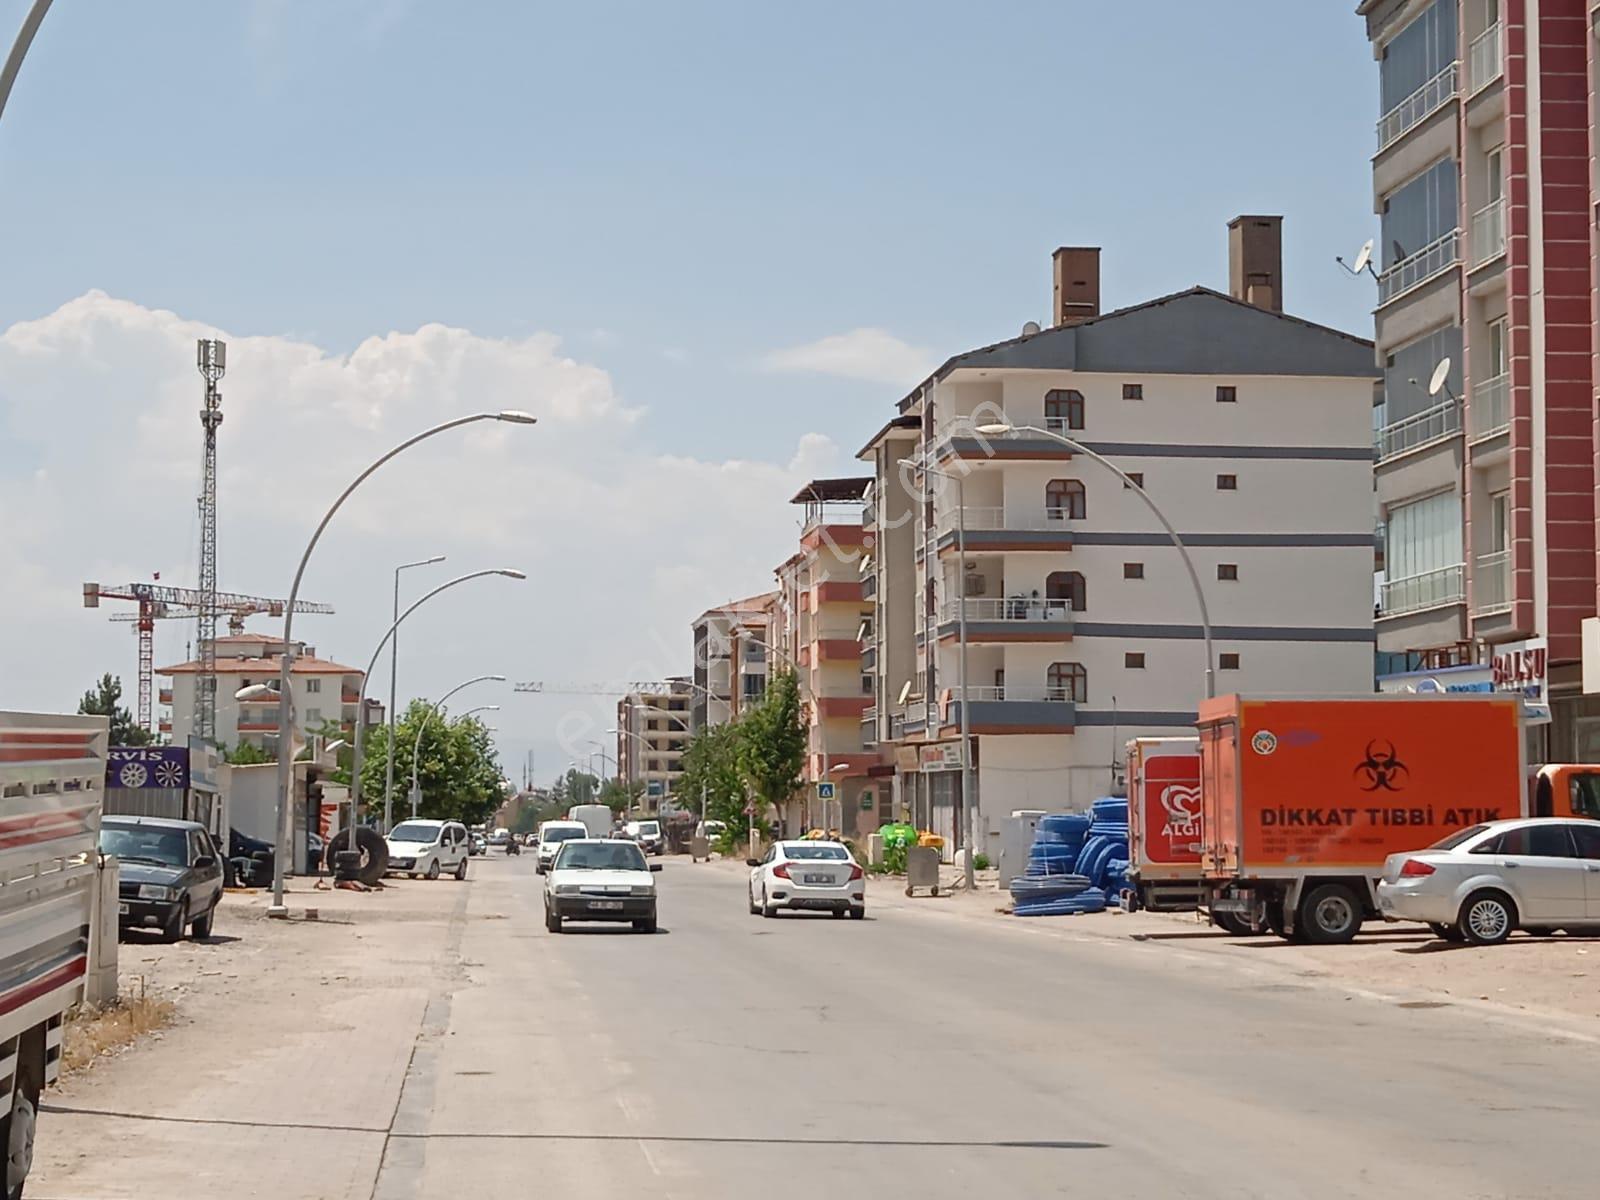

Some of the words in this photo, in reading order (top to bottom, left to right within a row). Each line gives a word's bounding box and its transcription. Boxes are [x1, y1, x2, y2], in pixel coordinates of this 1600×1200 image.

[1492, 648, 1545, 684] BALSU
[1261, 805, 1357, 826] DİKKAT
[1366, 804, 1434, 826] TIBBİ
[1443, 808, 1502, 826] ATIK
